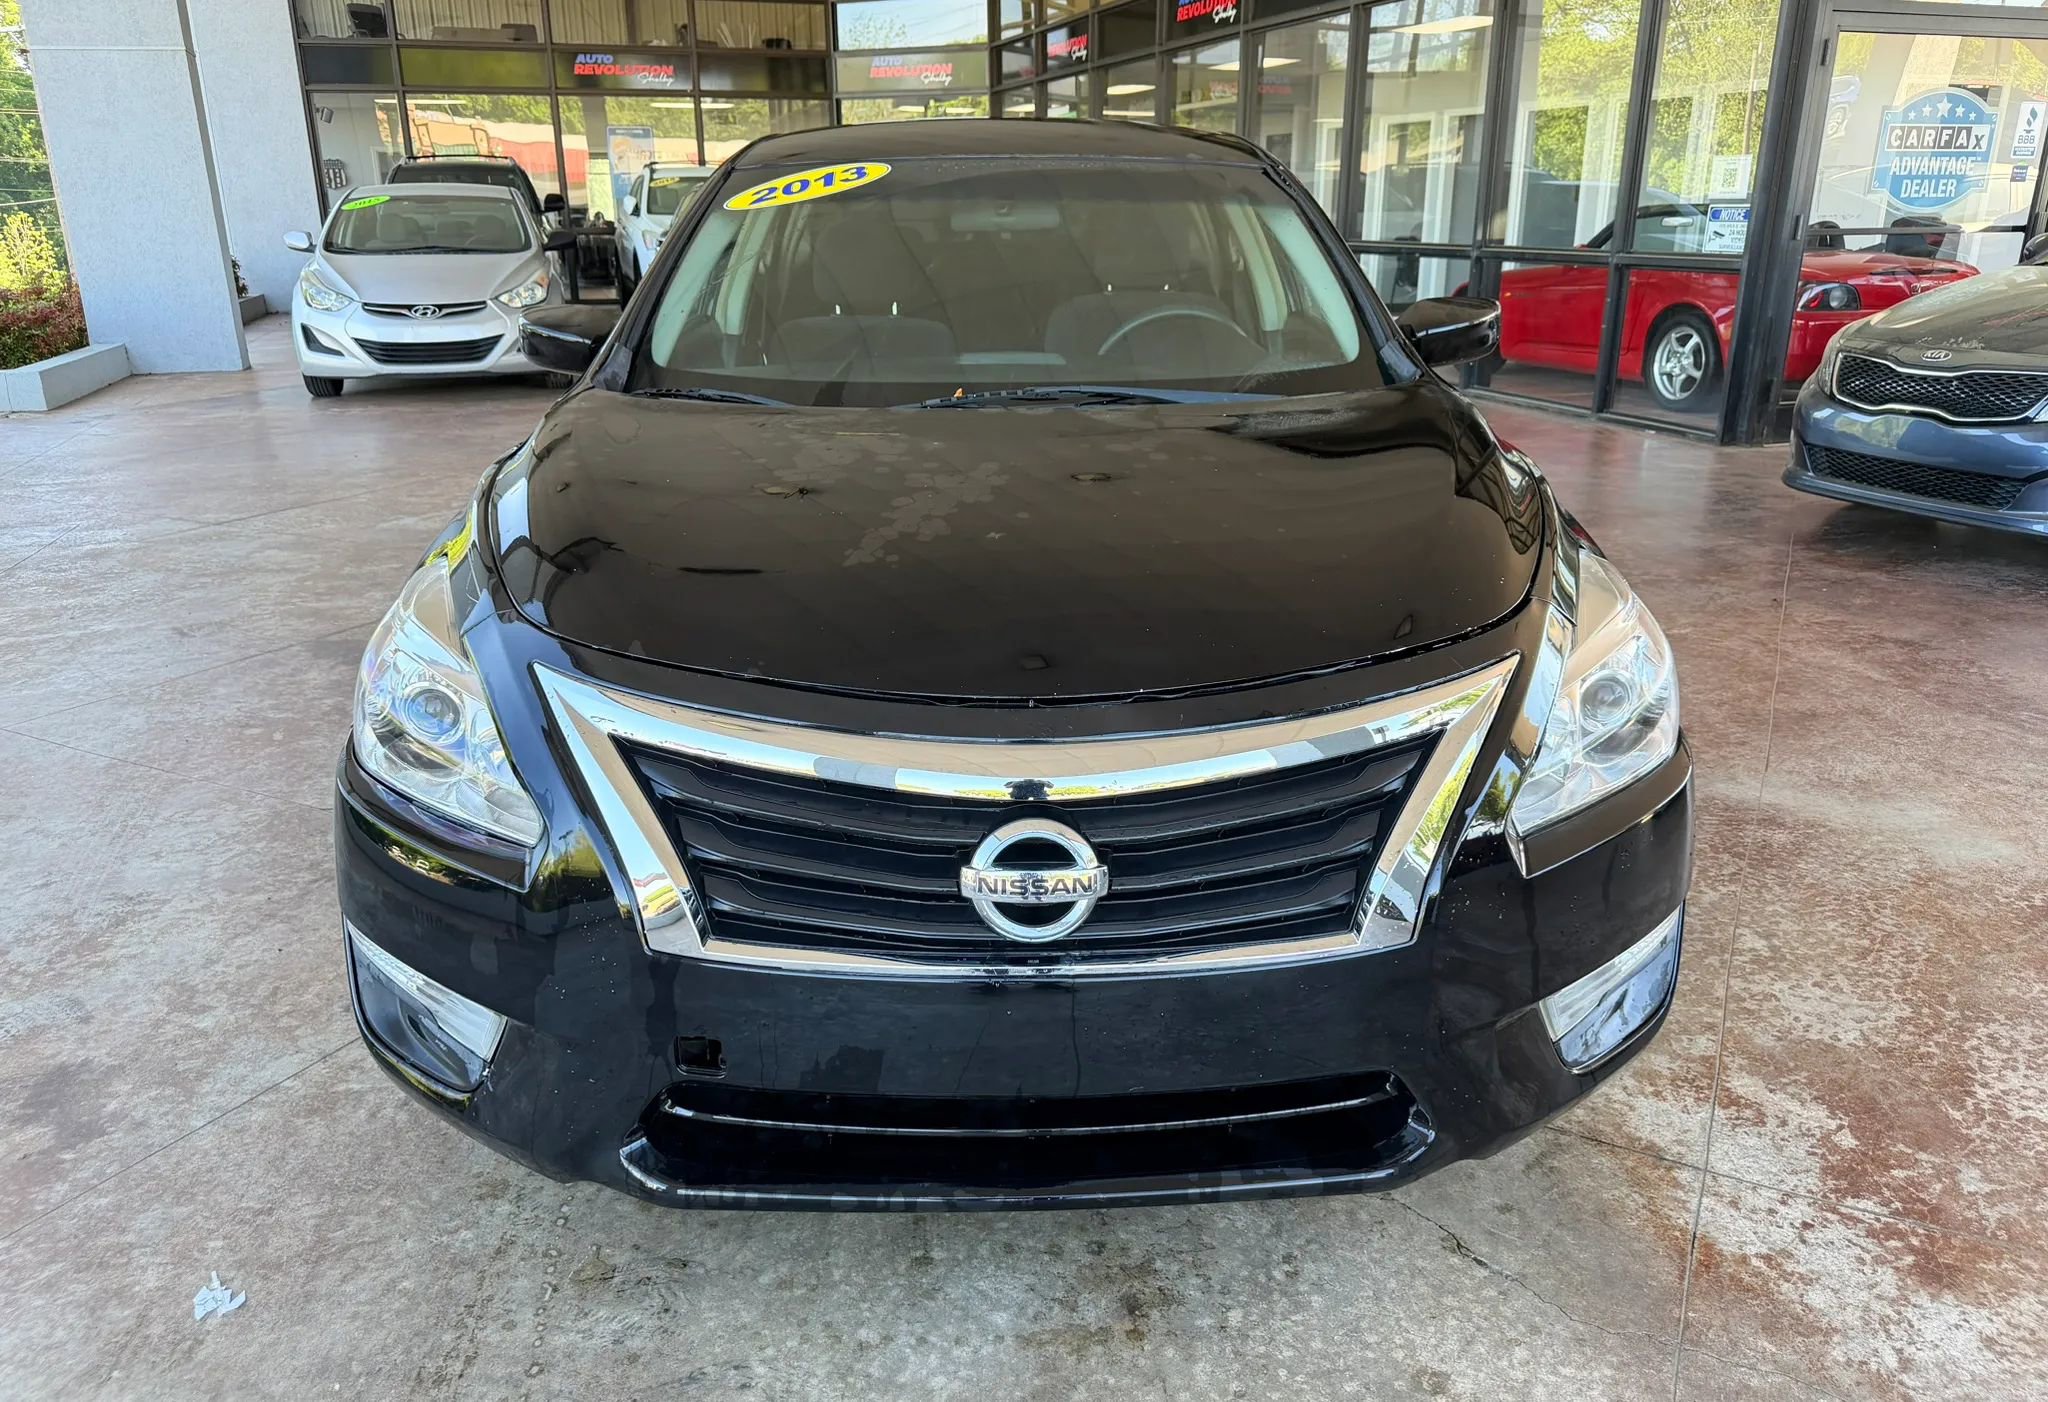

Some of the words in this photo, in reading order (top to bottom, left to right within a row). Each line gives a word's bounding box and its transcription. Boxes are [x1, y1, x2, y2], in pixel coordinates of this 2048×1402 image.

[575, 54, 614, 64] AUTO
[872, 55, 903, 67] AUTO
[574, 64, 674, 76] REVOLUTION
[870, 64, 953, 78] REVOLUTION
[1890, 127, 1985, 150] CARFAX
[1889, 156, 1975, 176] ADVANTAGE
[748, 166, 868, 206] 2013
[1900, 179, 1958, 198] DEALER
[1720, 208, 1747, 221] NOTICE
[1924, 350, 1946, 359] KIA
[976, 874, 1093, 897] NISSAN
